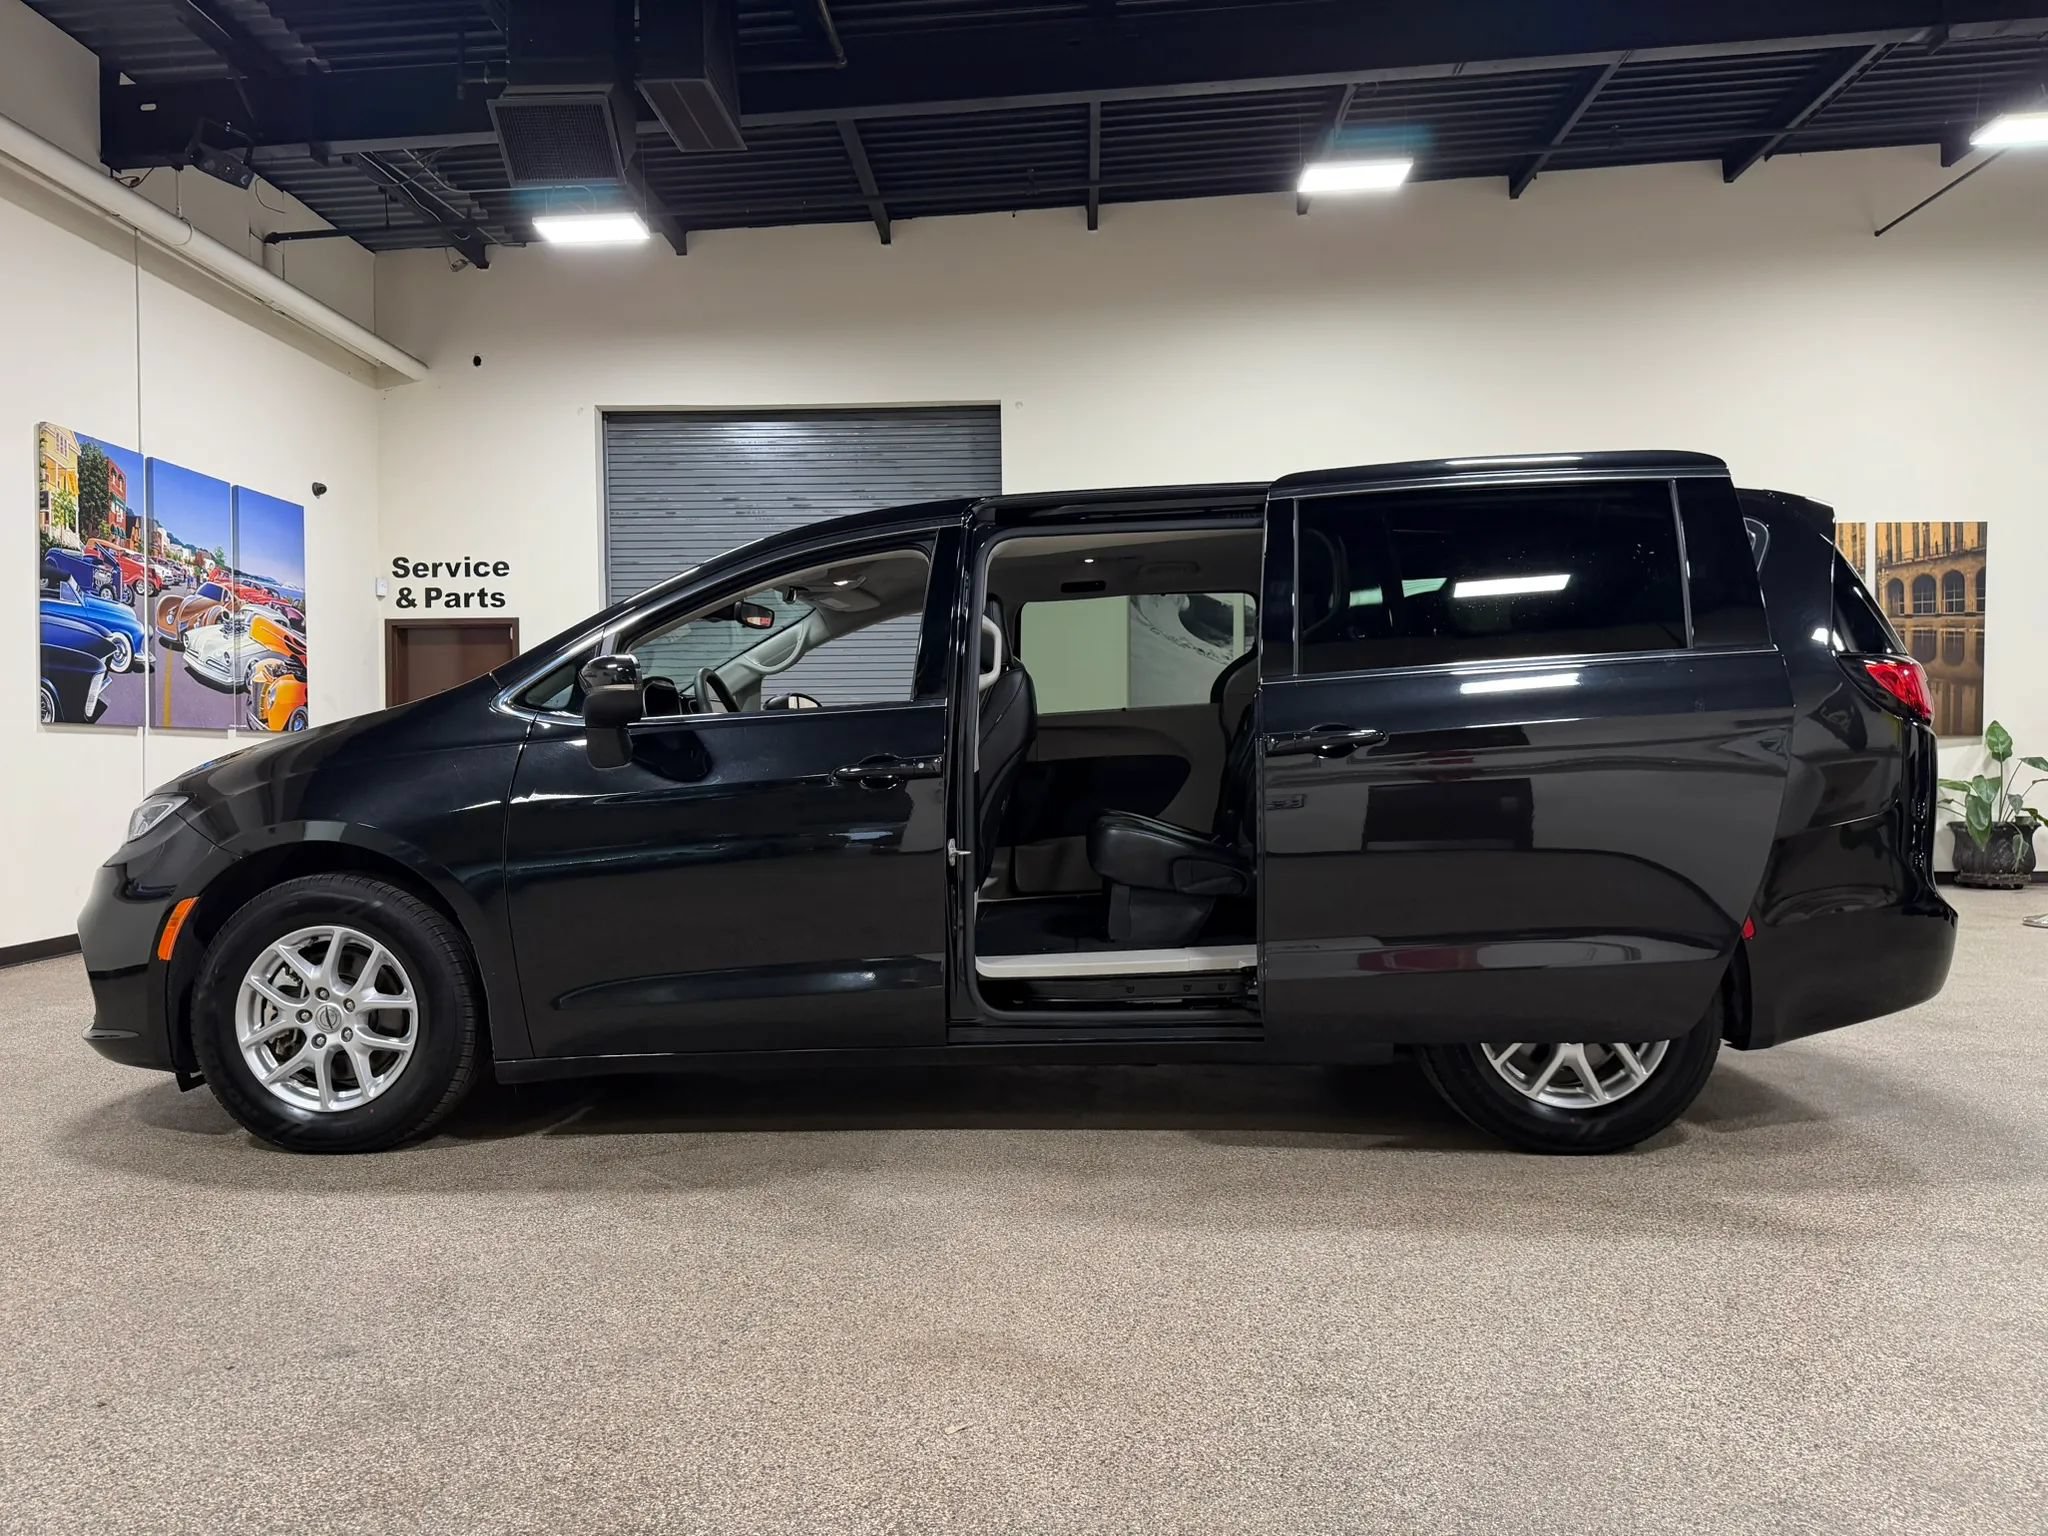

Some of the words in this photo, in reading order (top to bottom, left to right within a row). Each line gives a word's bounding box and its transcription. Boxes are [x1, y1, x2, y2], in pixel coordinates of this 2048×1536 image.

[391, 556, 510, 579] Service
[395, 586, 418, 609] &
[424, 586, 506, 609] Parts
